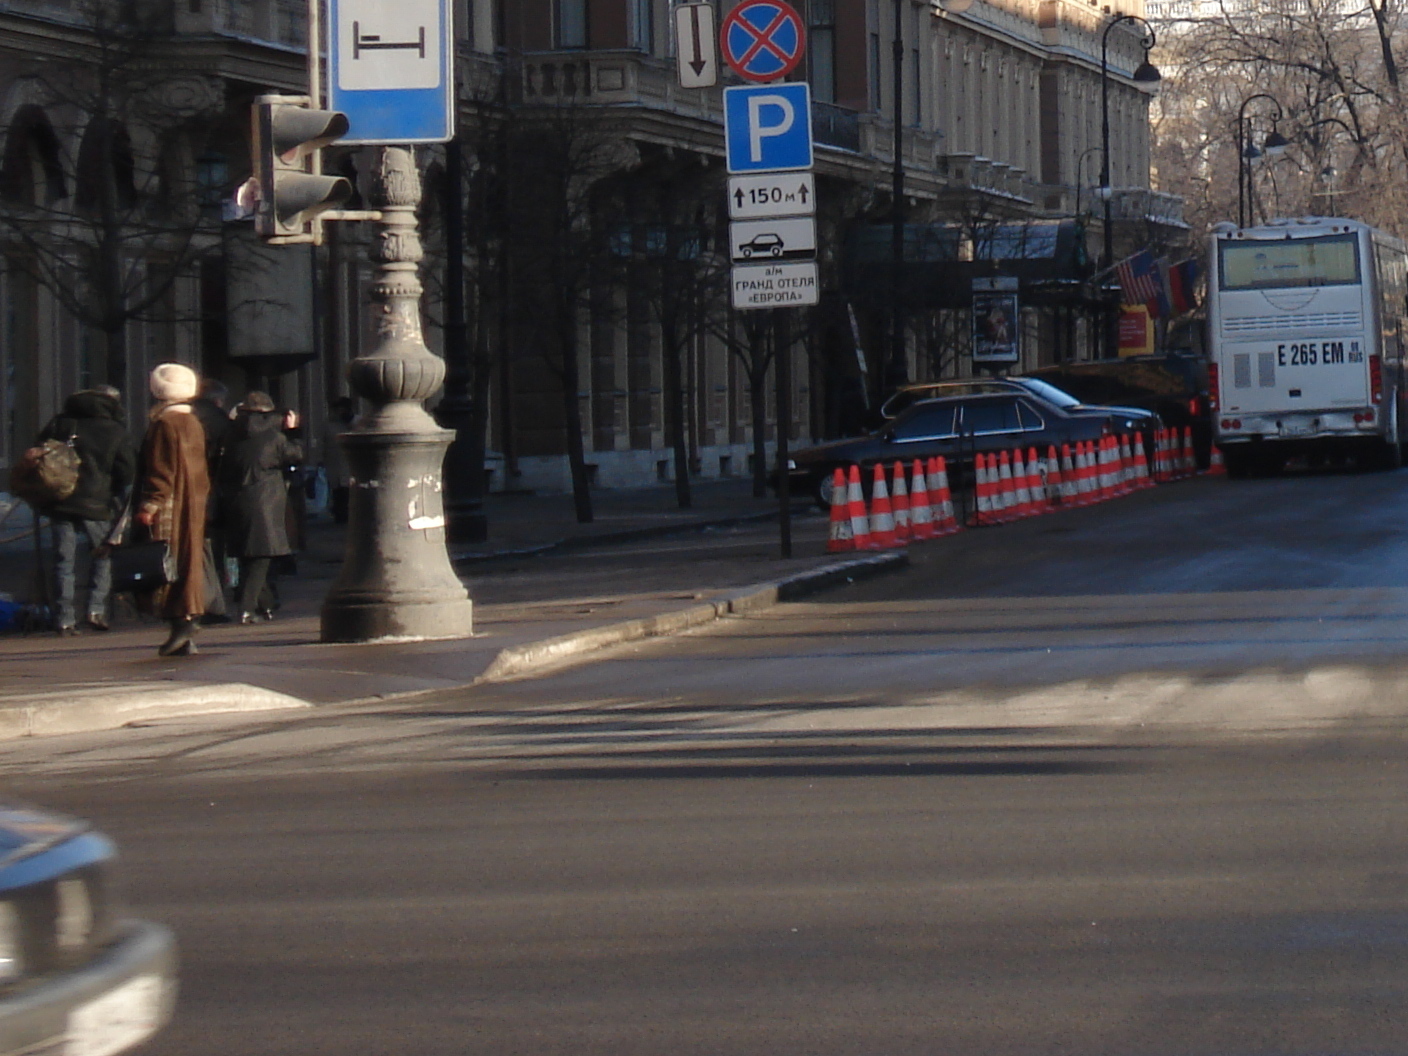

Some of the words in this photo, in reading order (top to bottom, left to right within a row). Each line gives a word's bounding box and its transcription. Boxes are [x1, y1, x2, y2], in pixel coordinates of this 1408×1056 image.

[748, 94, 795, 162] P
[749, 187, 782, 204] 150
[765, 266, 782, 276] а/м
[735, 279, 773, 291] ГРАНД
[777, 277, 814, 289] ОТЕЛЯ
[1291, 343, 1318, 365] 265
